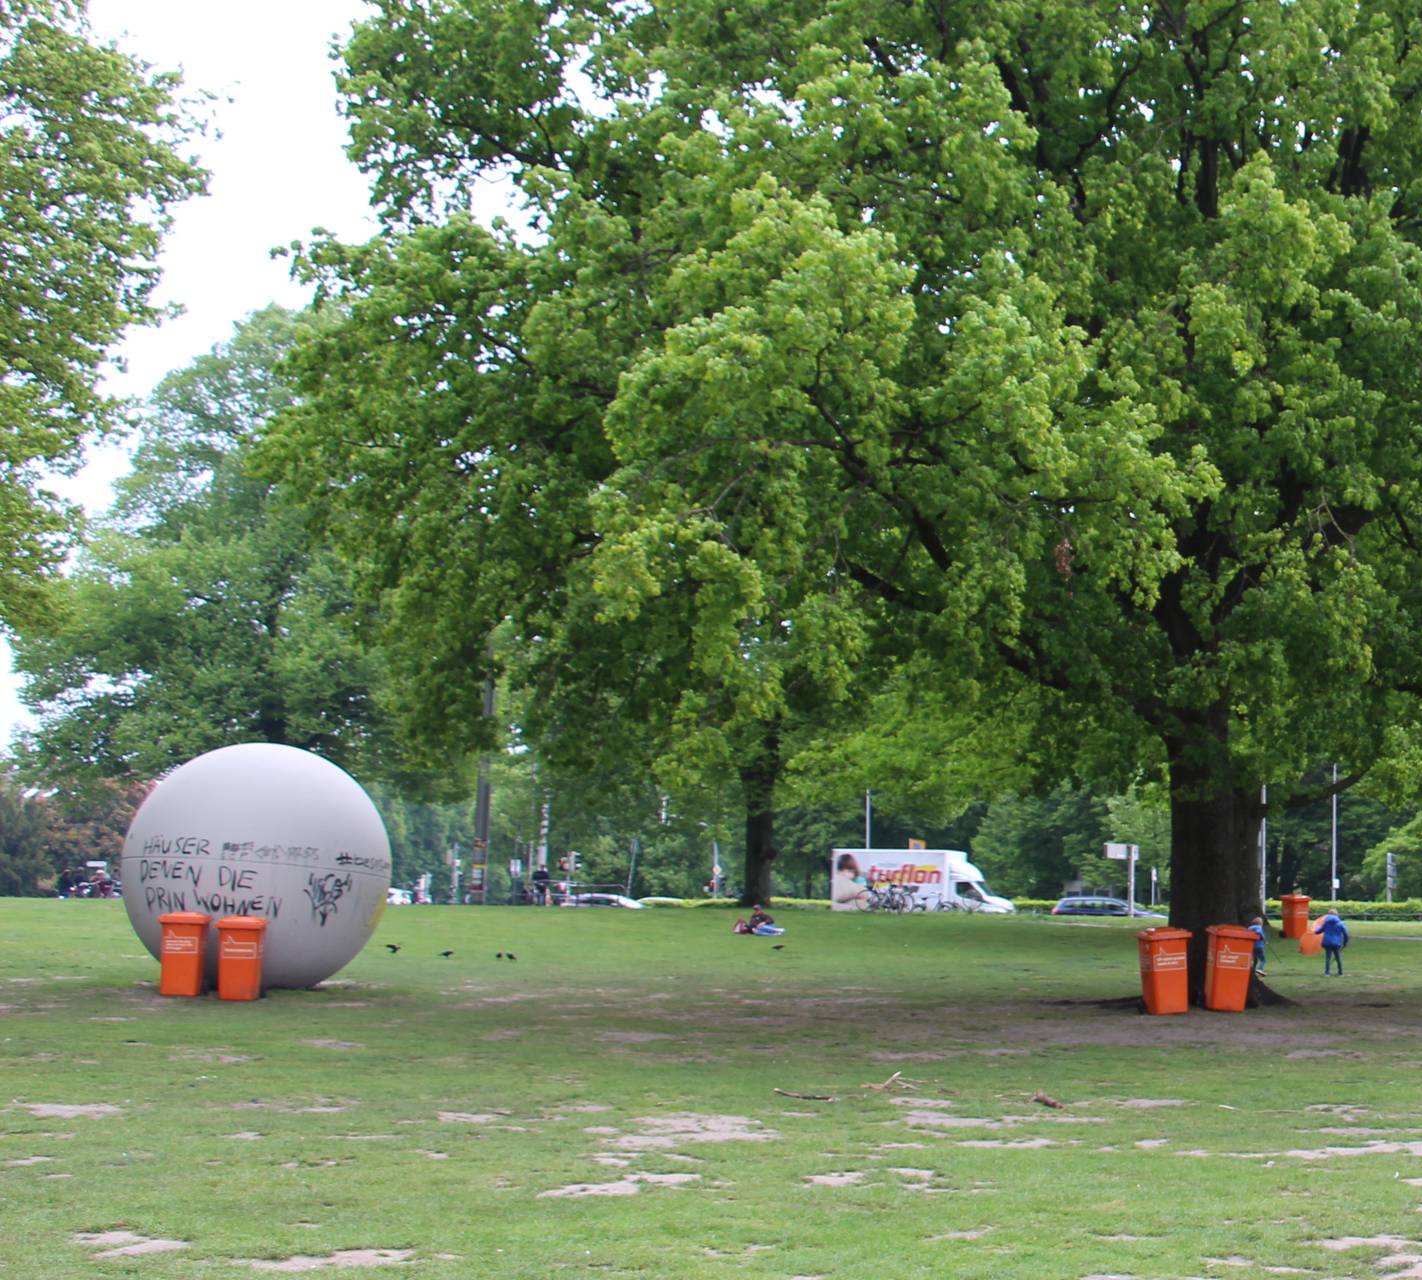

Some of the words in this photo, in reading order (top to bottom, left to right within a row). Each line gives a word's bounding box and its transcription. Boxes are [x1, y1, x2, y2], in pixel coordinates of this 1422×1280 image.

[143, 834, 211, 856] HÄUSER
[218, 865, 258, 891] DIE
[193, 888, 283, 918] WOHNEN
